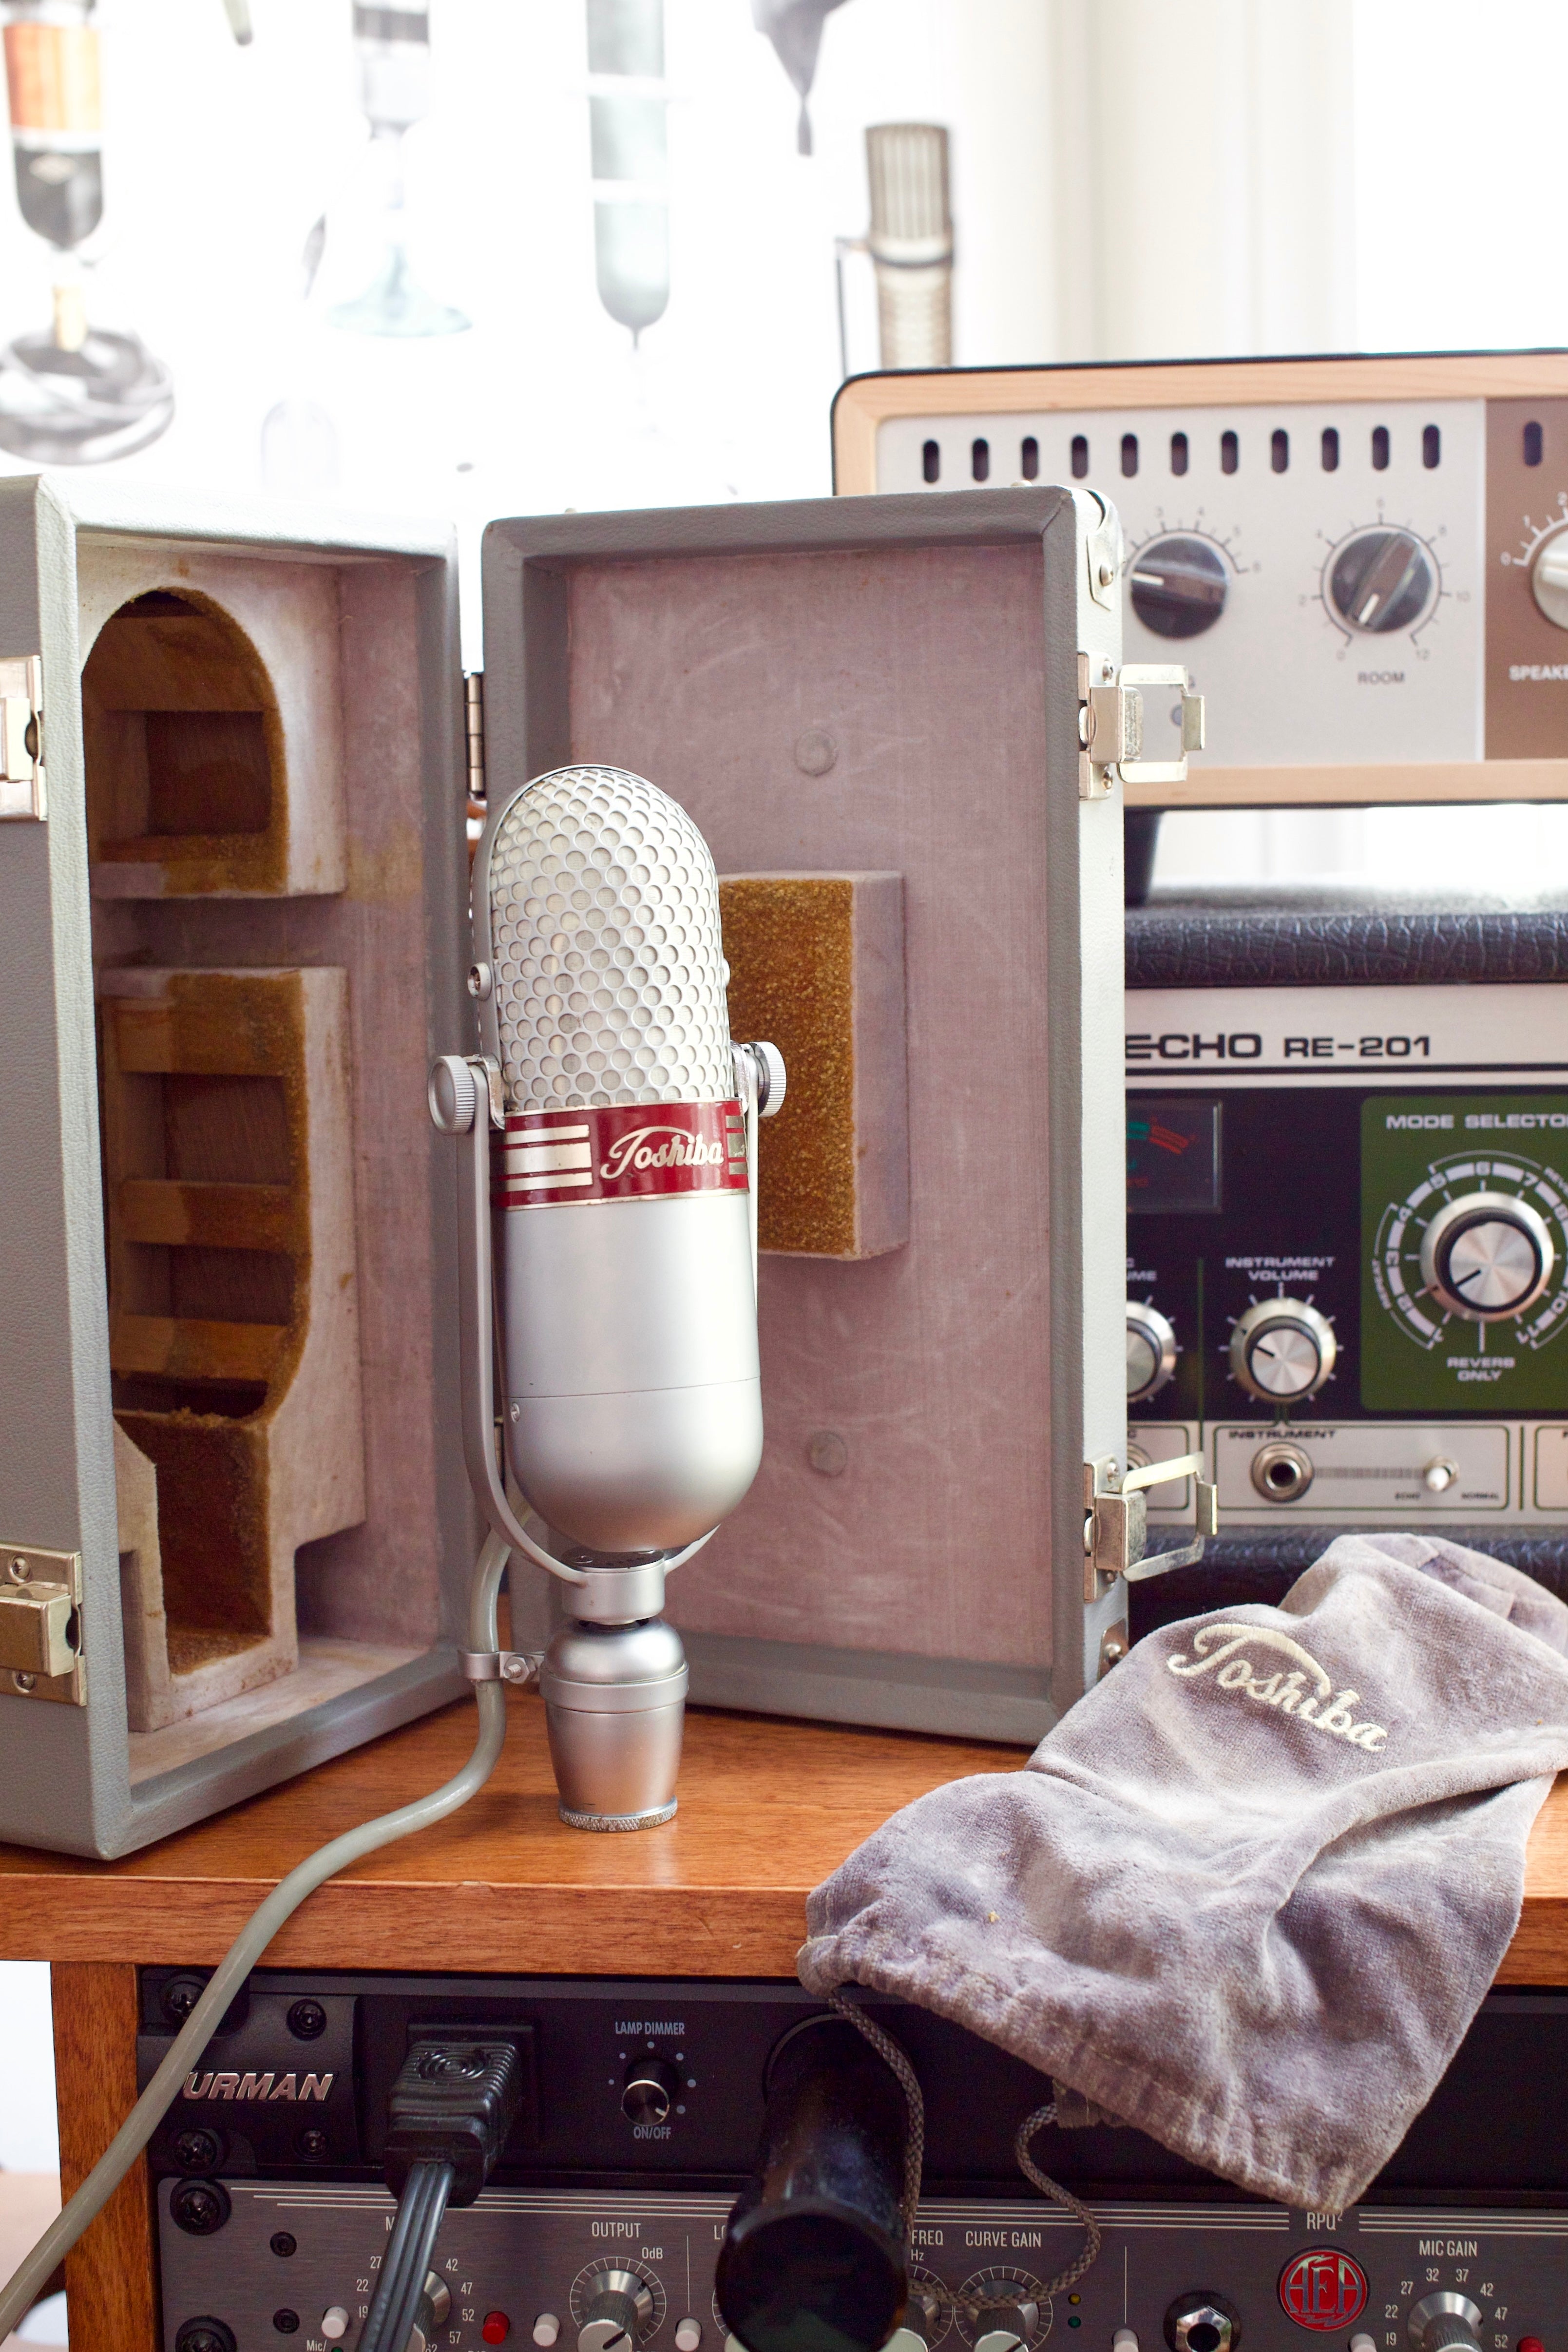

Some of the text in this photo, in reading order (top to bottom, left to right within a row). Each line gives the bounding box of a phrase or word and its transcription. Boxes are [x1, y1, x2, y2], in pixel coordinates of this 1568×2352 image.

[1358, 671, 1405, 683] ROOM
[1509, 664, 1568, 681] SPEAKE
[1126, 1033, 1430, 1059] ECHO RE-201
[1386, 1113, 1568, 1129] MODE SELECTO
[600, 1126, 724, 1180] Toshiba
[1523, 1171, 1539, 1187] 7
[1225, 1256, 1335, 1267] INSTRUMENT
[1247, 1270, 1319, 1281] VOLUME
[1447, 1357, 1515, 1368] REVERB
[1457, 1370, 1502, 1381] ONLY
[1229, 1430, 1336, 1439] INSTRUMENT
[1167, 1623, 1388, 1753] Toshiba
[615, 2022, 685, 2035] LAMP DIMMER
[183, 2072, 334, 2101] URMAN
[633, 2126, 671, 2140] ON/OFF
[592, 2221, 641, 2238] OUTPUT
[911, 2230, 943, 2245] FREQ
[965, 2231, 1041, 2247] CURVE GAIN
[642, 2247, 663, 2259] 0dB
[911, 2249, 924, 2261] Hz
[1419, 2240, 1477, 2257] MIC GAIN
[370, 2256, 382, 2269] 27
[446, 2258, 458, 2271] 42
[1426, 2268, 1439, 2282] 32
[1455, 2269, 1469, 2282] 37
[357, 2279, 369, 2292] 22
[461, 2282, 473, 2295] 47
[1401, 2281, 1414, 2295] 27
[1480, 2282, 1493, 2297] 42
[359, 2305, 368, 2318] 19
[462, 2309, 474, 2321] 52
[1385, 2305, 1398, 2318] 22
[1494, 2306, 1508, 2320] 47
[449, 2331, 461, 2344] 57
[1386, 2332, 1396, 2346] 19
[1494, 2334, 1508, 2348] 52
[306, 2340, 327, 2352] Mic/
